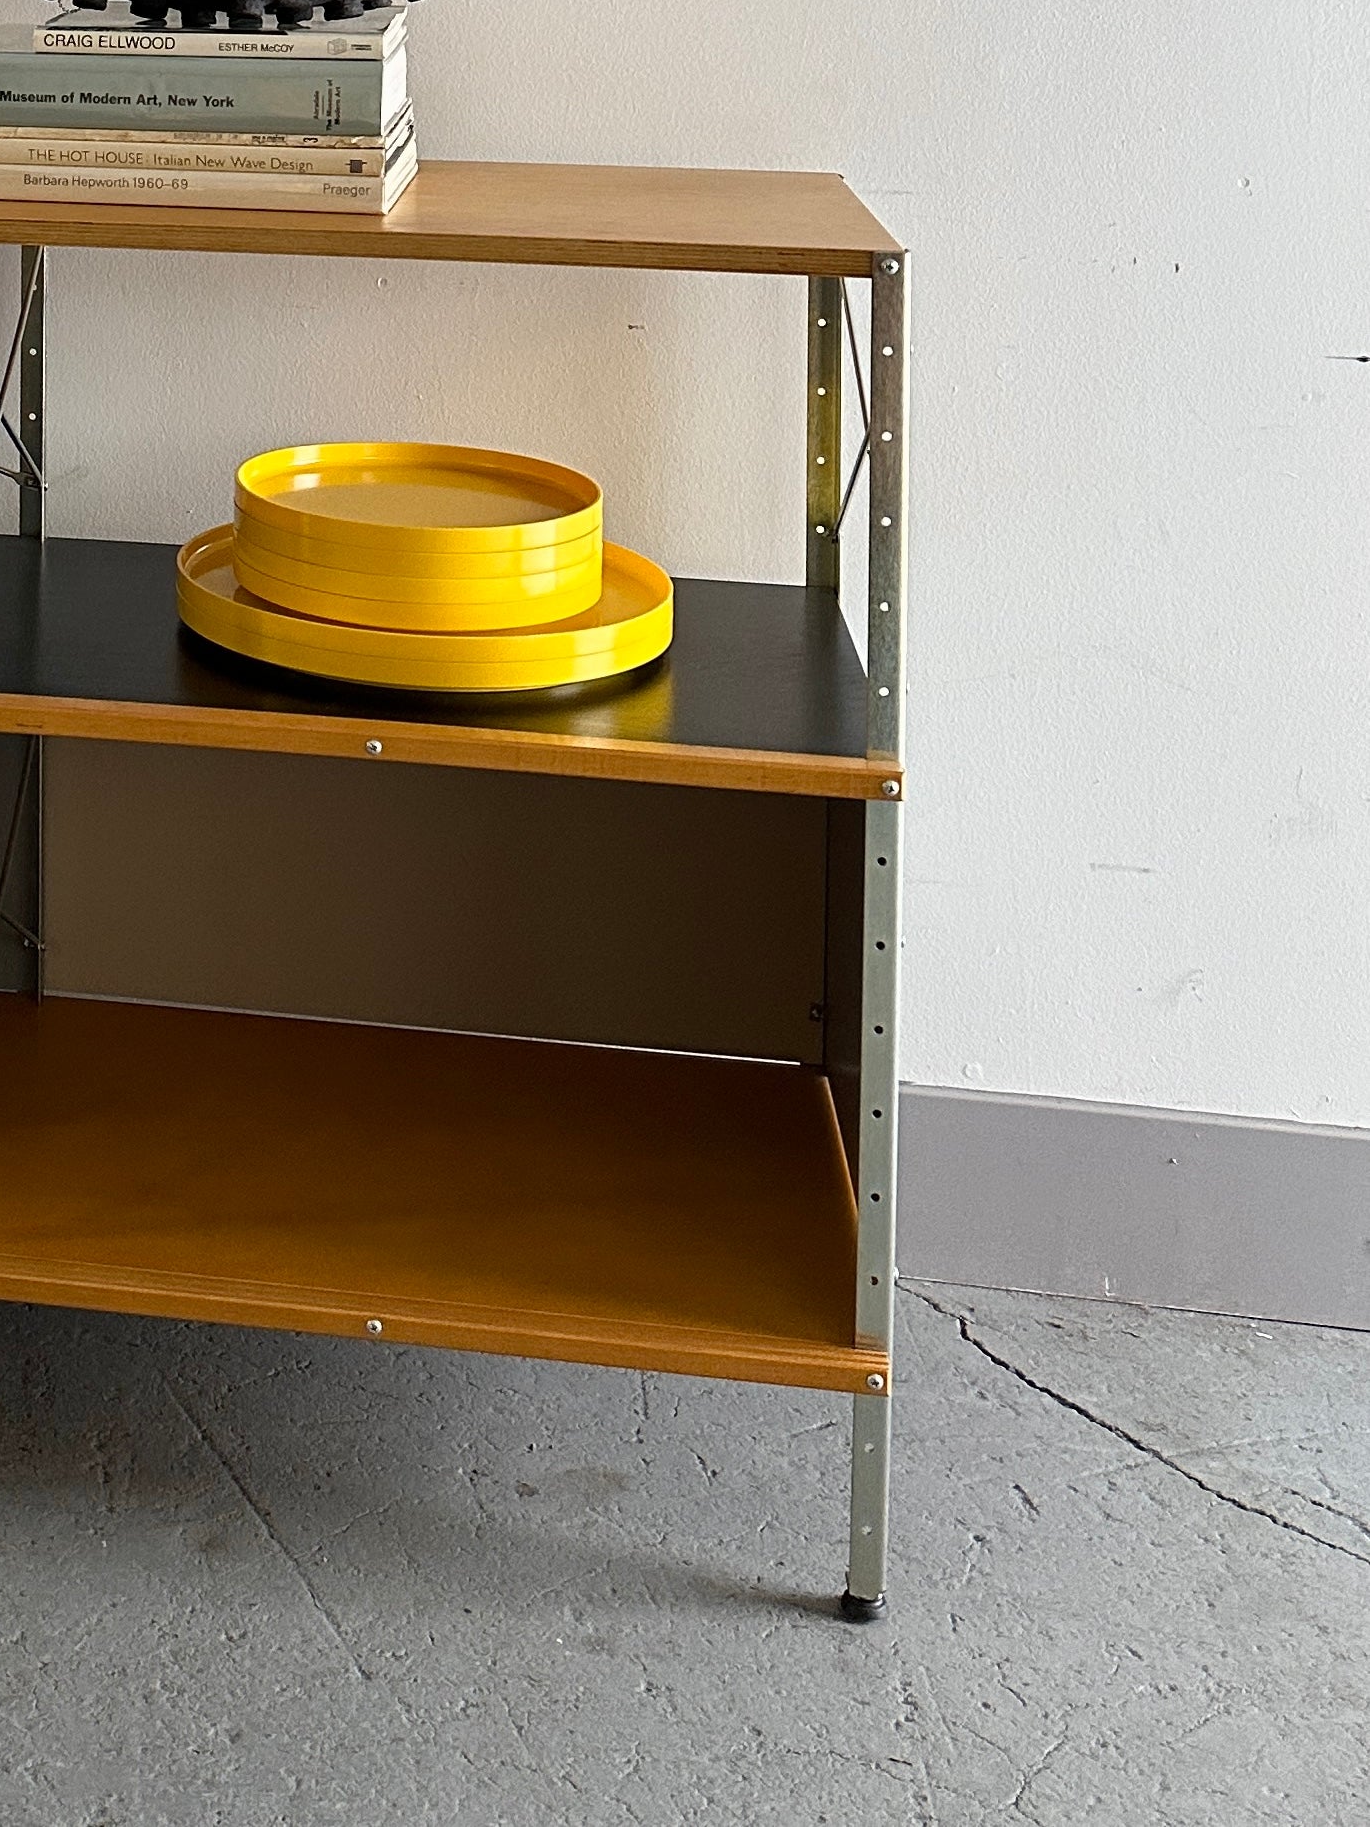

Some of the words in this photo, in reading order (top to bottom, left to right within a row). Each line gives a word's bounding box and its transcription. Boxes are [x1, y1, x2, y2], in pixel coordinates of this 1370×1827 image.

[43, 33, 93, 49] CRAIG
[98, 34, 176, 51] ELLWOOD
[218, 42, 258, 53] ESTHER
[0, 90, 56, 104] Museum
[61, 91, 75, 104] of
[80, 92, 131, 105] Modern
[136, 94, 162, 108] Art,
[168, 95, 198, 107] New
[202, 95, 235, 108] York
[28, 148, 54, 162] THE
[59, 150, 89, 163] HOT
[153, 153, 191, 166] Italian
[195, 154, 225, 167] New
[230, 156, 266, 168] Wave
[270, 157, 314, 173] Design
[23, 174, 69, 186] Barbara
[71, 175, 130, 189] Hepworth
[322, 183, 372, 198] Praeger
